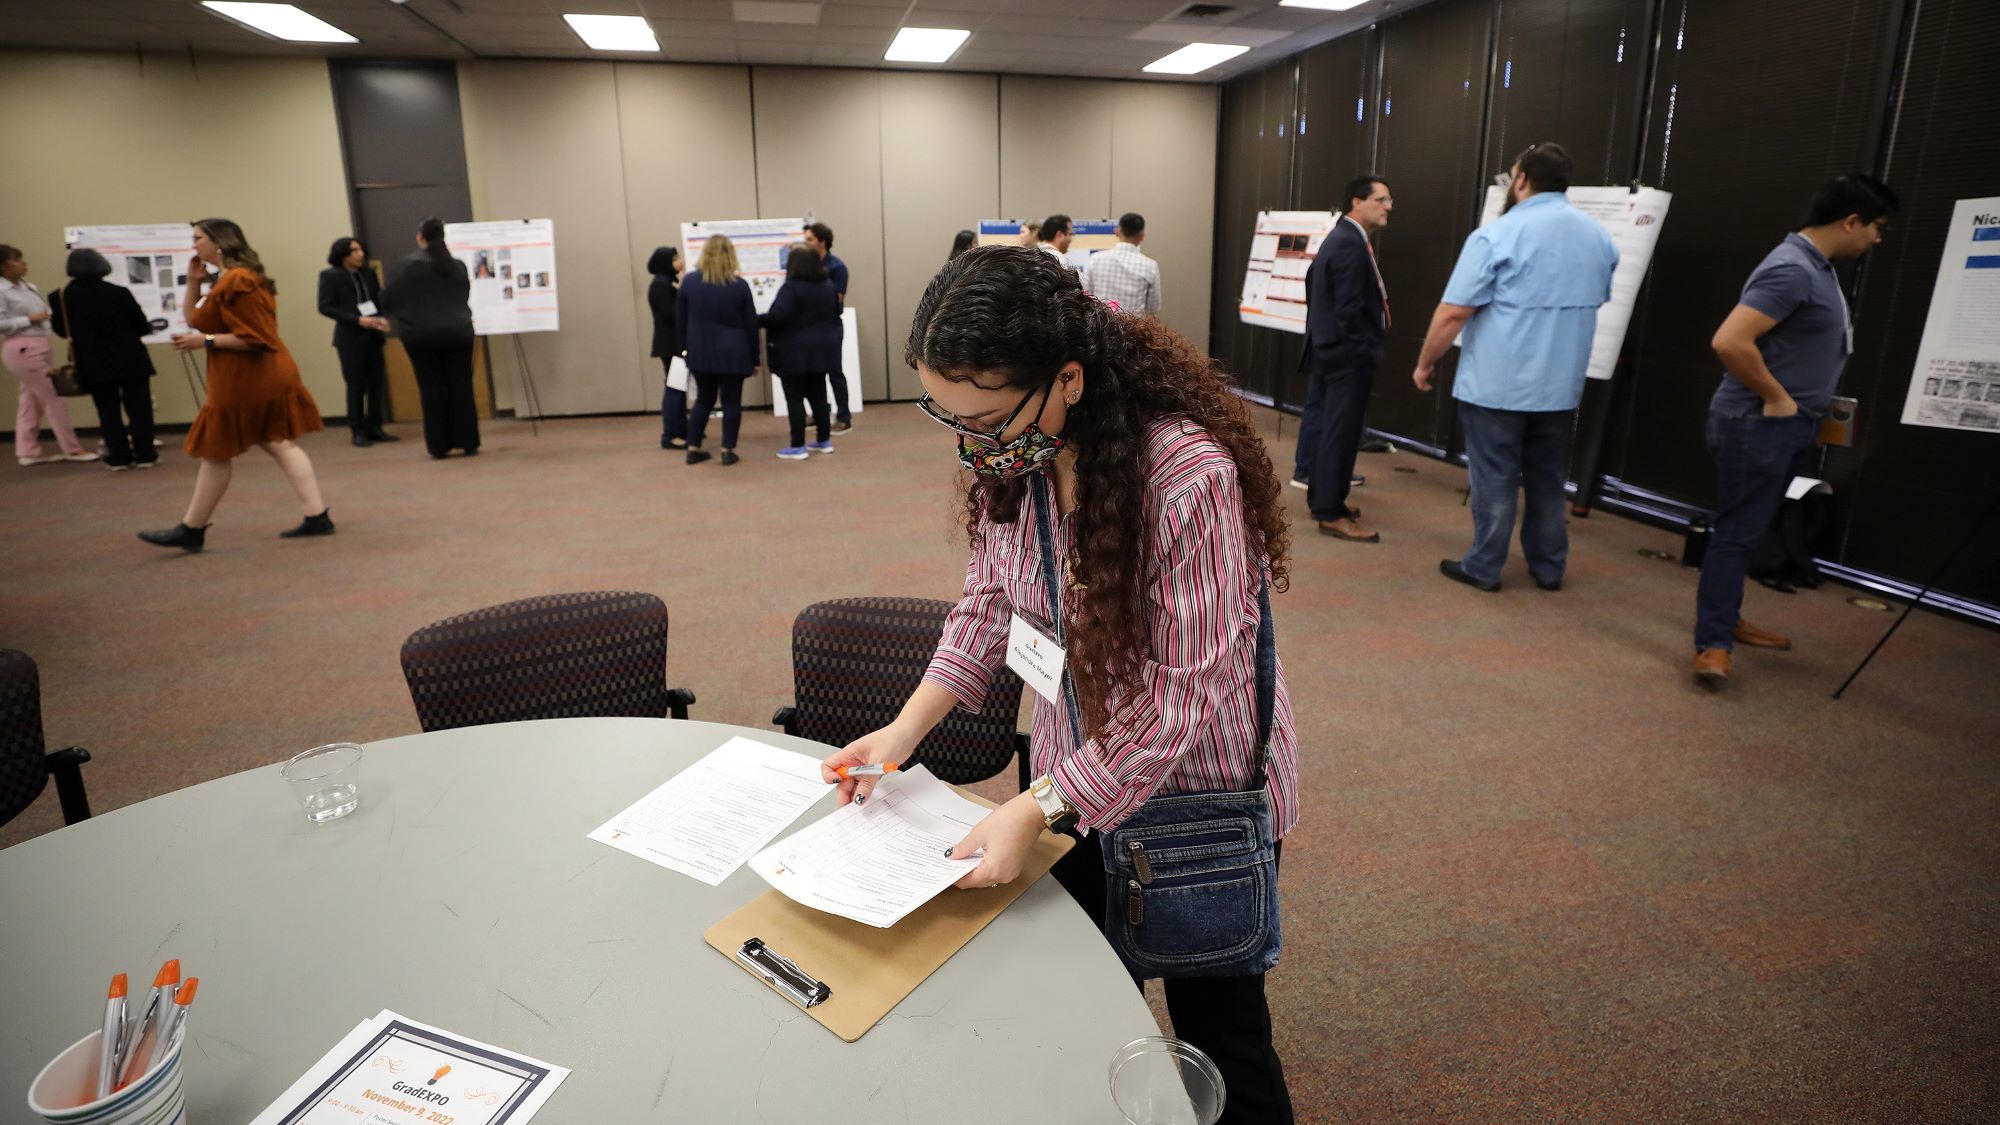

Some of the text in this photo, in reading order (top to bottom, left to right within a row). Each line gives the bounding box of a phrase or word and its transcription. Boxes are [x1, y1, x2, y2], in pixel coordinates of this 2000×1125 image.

[1973, 213, 2000, 226] Nic
[392, 1081, 450, 1106] GradEXPO
[362, 1088, 455, 1125] November 9, 2022
